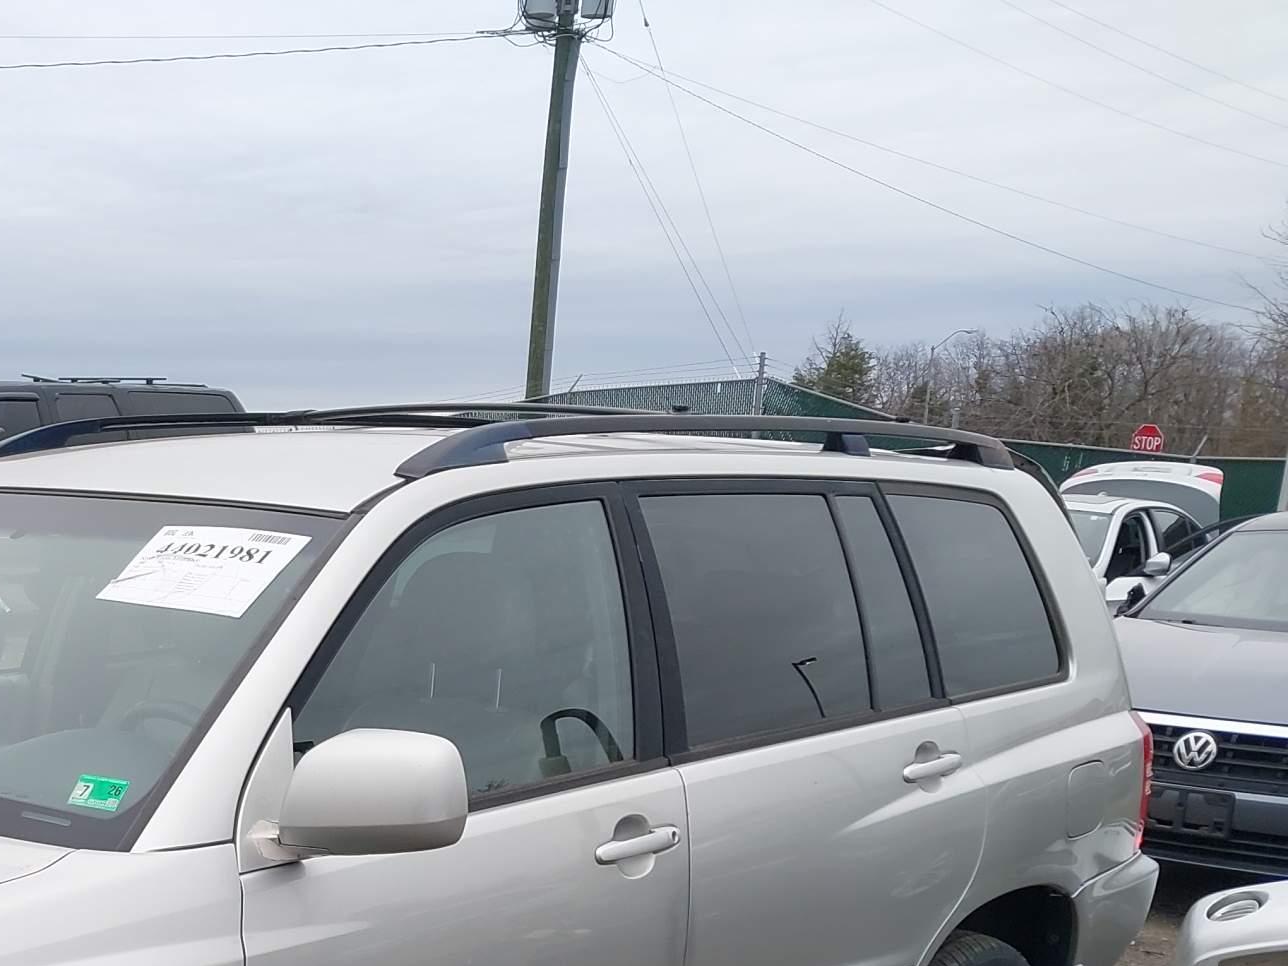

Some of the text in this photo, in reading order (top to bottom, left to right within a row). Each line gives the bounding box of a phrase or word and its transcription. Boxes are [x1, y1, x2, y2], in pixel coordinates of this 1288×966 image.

[1133, 435, 1161, 450] STOP
[155, 541, 274, 565] 44021981
[79, 784, 124, 797] 7 26
